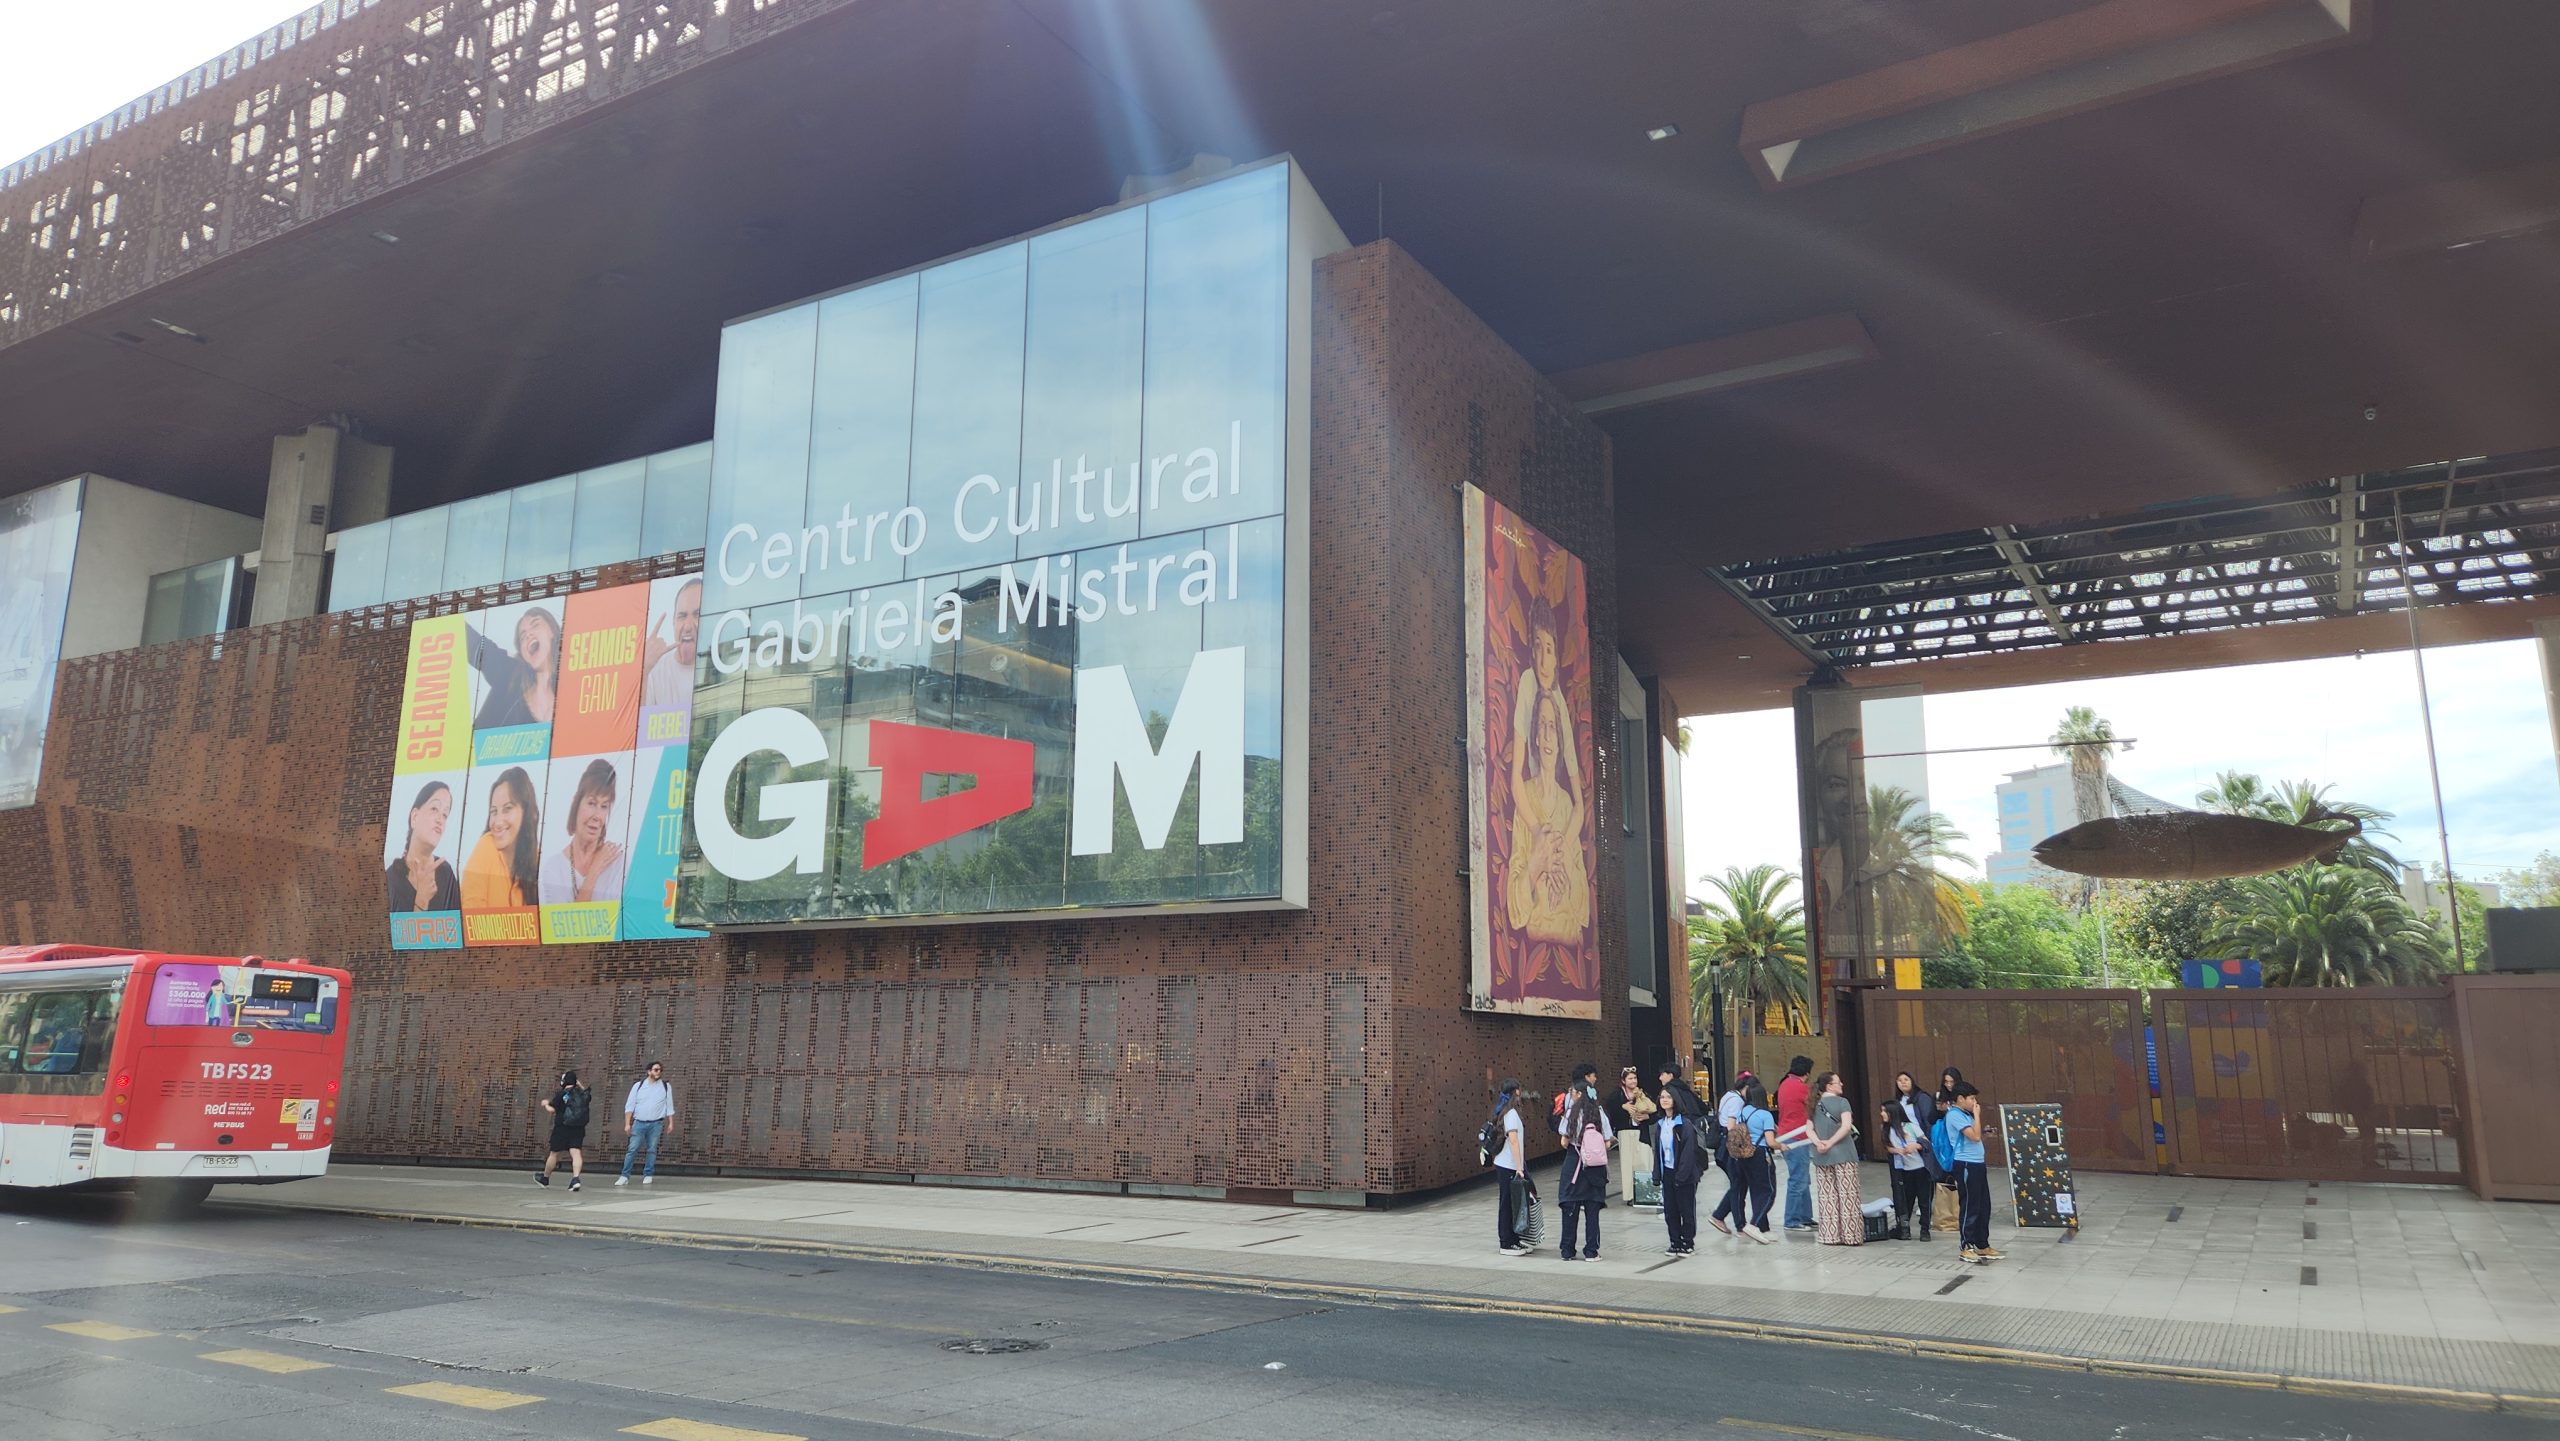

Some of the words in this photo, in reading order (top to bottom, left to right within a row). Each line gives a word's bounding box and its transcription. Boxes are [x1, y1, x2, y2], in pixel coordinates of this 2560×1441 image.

[717, 501, 927, 587] Centro
[953, 420, 1242, 543] Cultural
[710, 578, 963, 675] Gabriela
[998, 524, 1240, 634] Mistral
[568, 624, 638, 672] SEAMOS
[406, 632, 455, 761] SEAMOS
[578, 671, 618, 714] GAM
[693, 645, 1246, 882] GAM
[168, 990, 206, 999] $360.000
[201, 1062, 225, 1079] TB
[227, 1063, 248, 1079] FS
[249, 1064, 273, 1080] 23
[204, 1101, 227, 1115] Red
